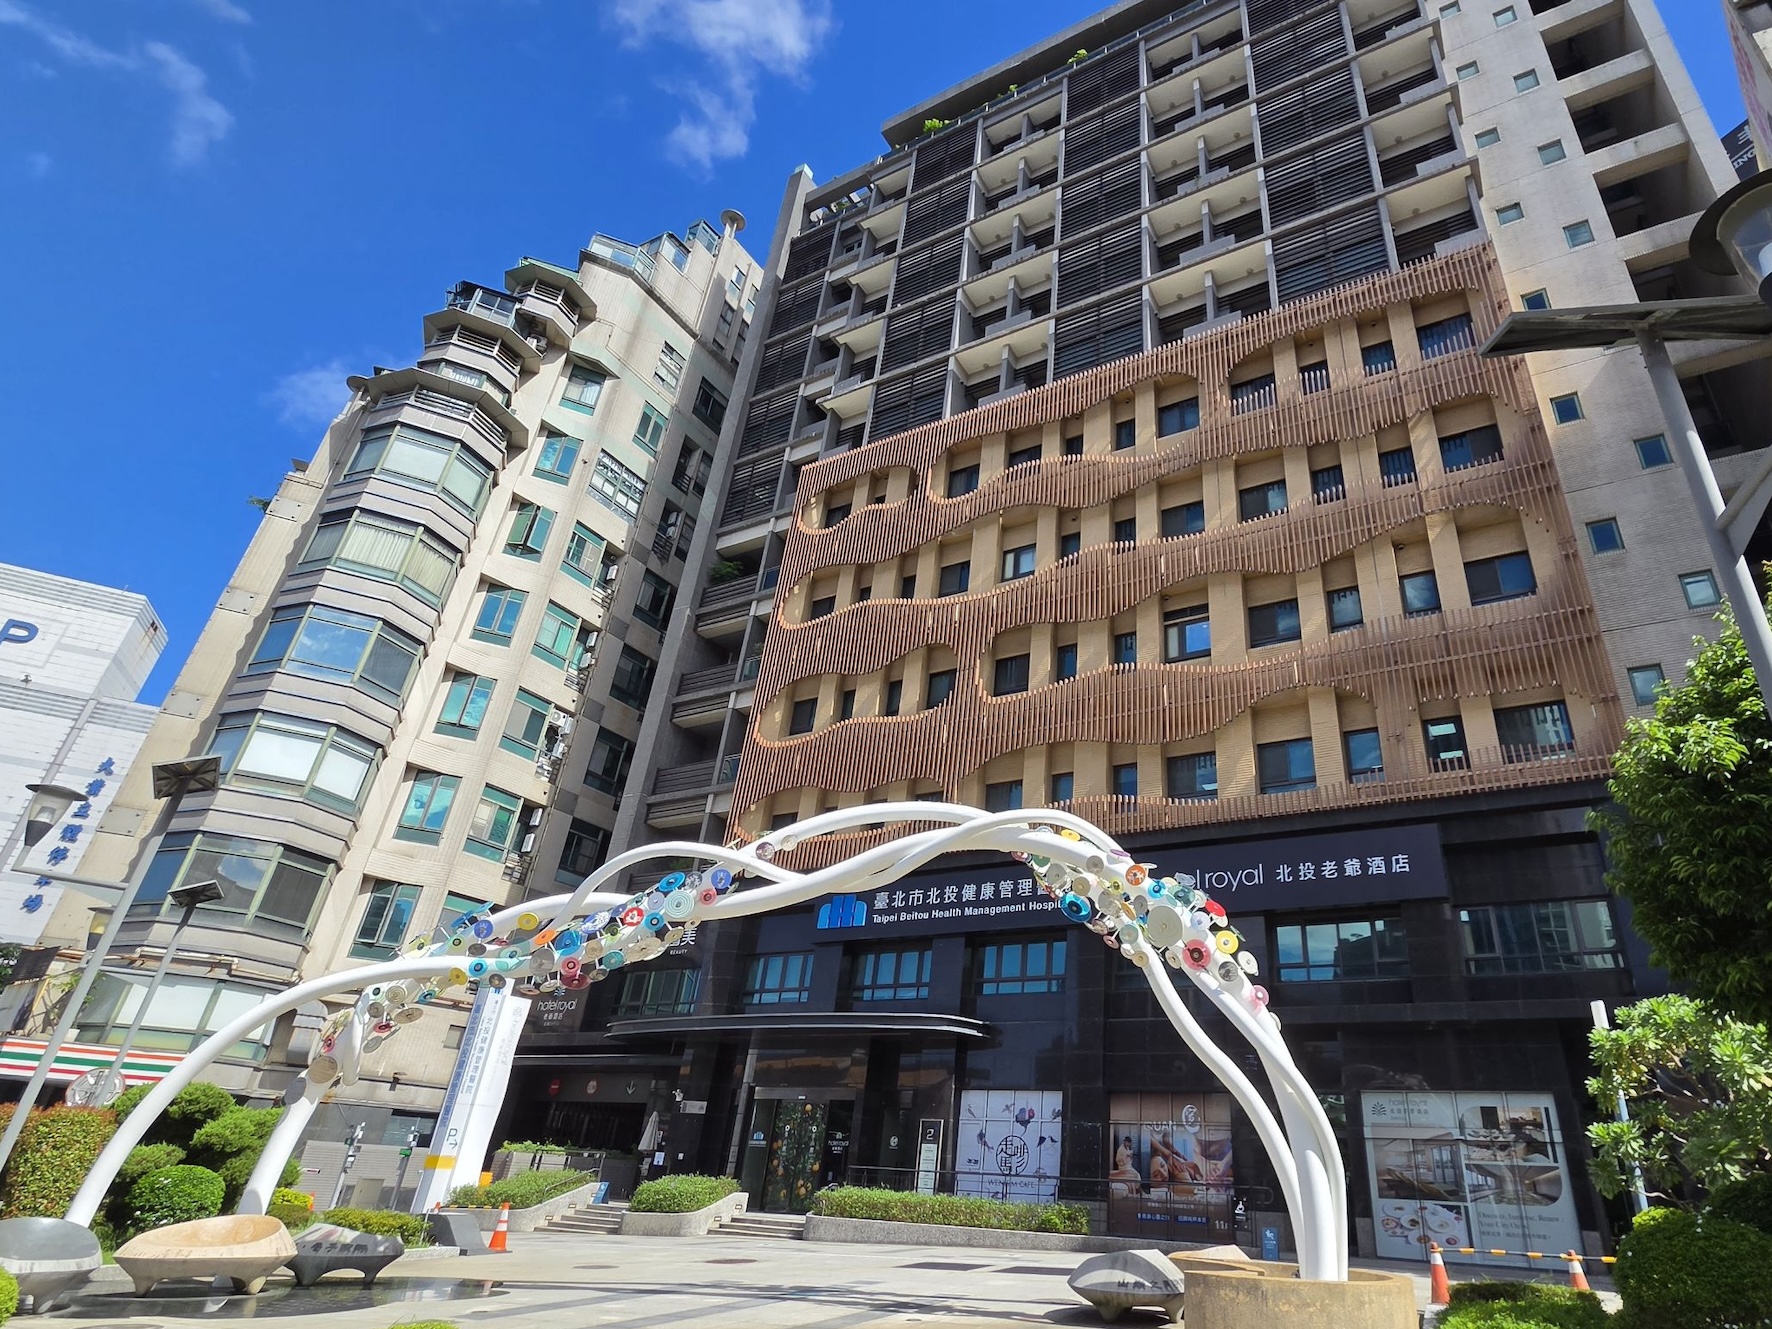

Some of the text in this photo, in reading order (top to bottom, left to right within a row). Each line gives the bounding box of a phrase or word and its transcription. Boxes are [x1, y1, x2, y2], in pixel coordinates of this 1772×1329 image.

[0, 618, 39, 645] P
[1276, 853, 1411, 883] 北投老爺酒店
[872, 912, 898, 924] Taipei
[900, 909, 929, 921] Beitou
[931, 907, 962, 919] Health
[964, 902, 1026, 917] Management
[446, 1128, 458, 1142] P
[926, 1128, 935, 1140] 2
